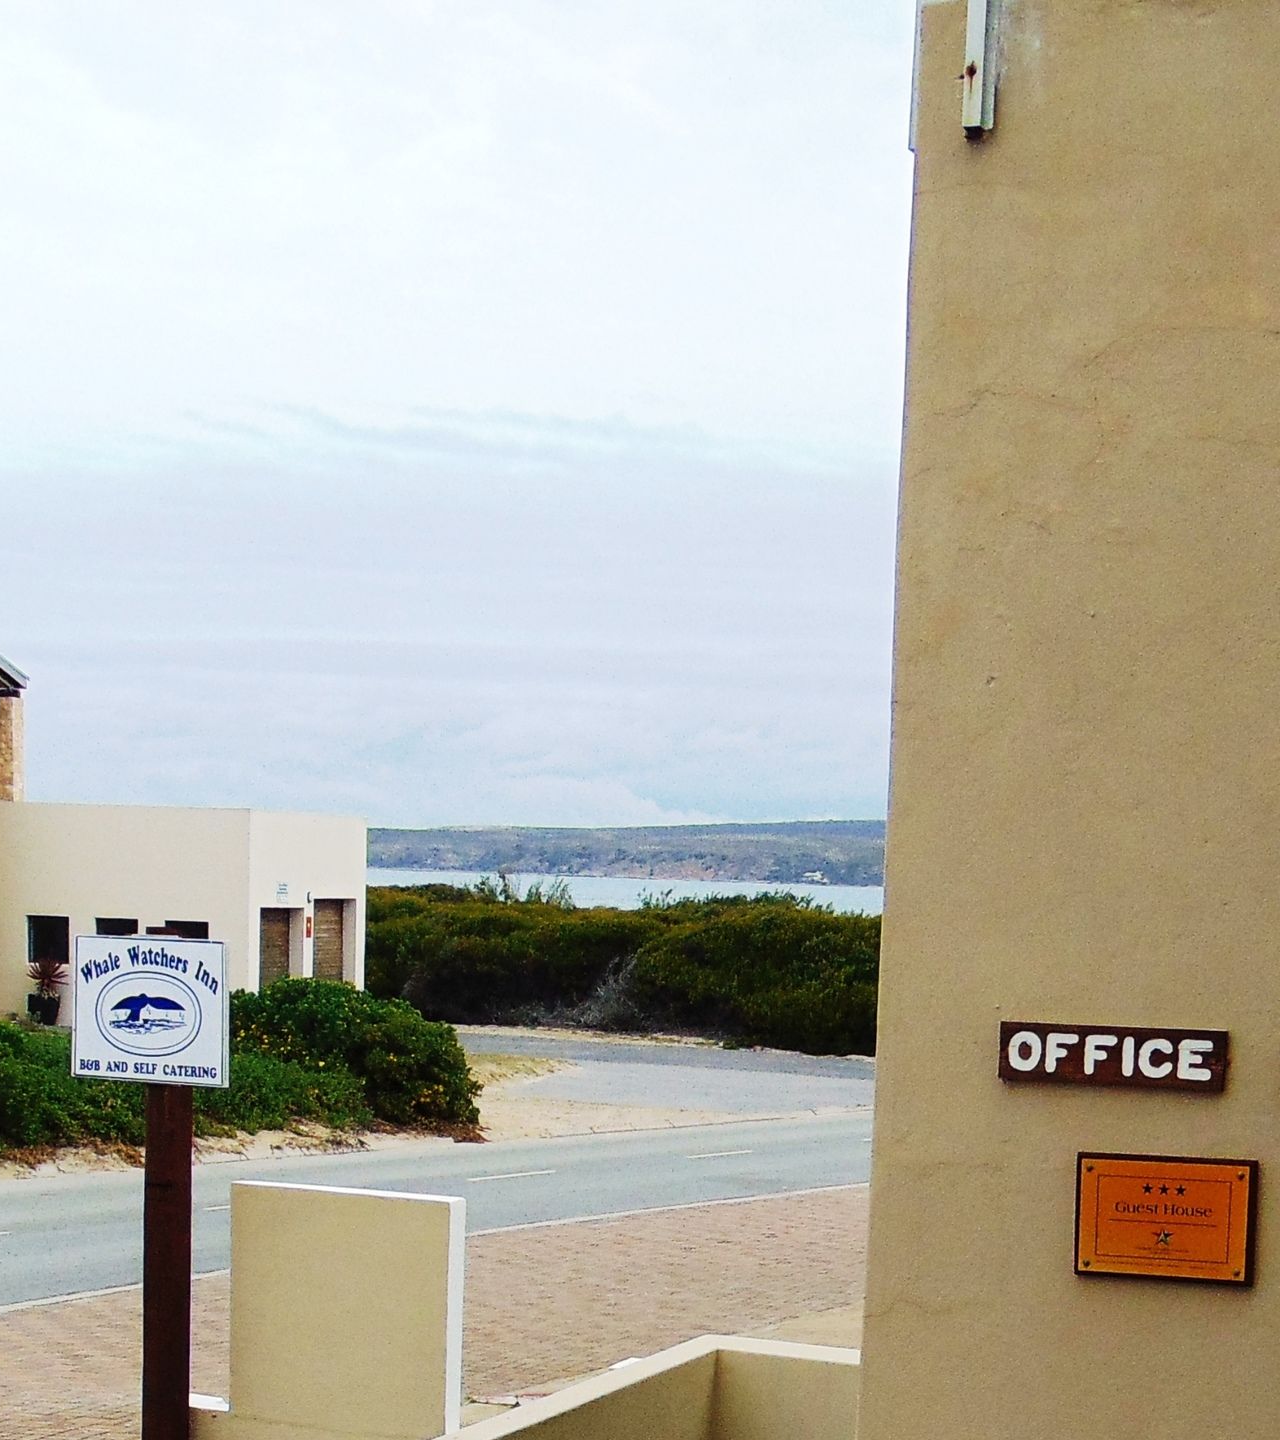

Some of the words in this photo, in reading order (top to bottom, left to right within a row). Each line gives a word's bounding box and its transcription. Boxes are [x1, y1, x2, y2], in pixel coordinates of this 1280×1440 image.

[81, 952, 120, 984] Whale
[127, 945, 189, 974] Watchers
[195, 961, 219, 995] Inn
[79, 1058, 101, 1071] B&B
[106, 1060, 128, 1073] AND
[133, 1062, 158, 1075] SELF
[163, 1064, 218, 1079] CATERING
[1008, 1031, 1214, 1081] OFFICE
[1114, 1200, 1158, 1215] Guest
[1163, 1203, 1213, 1218] House
